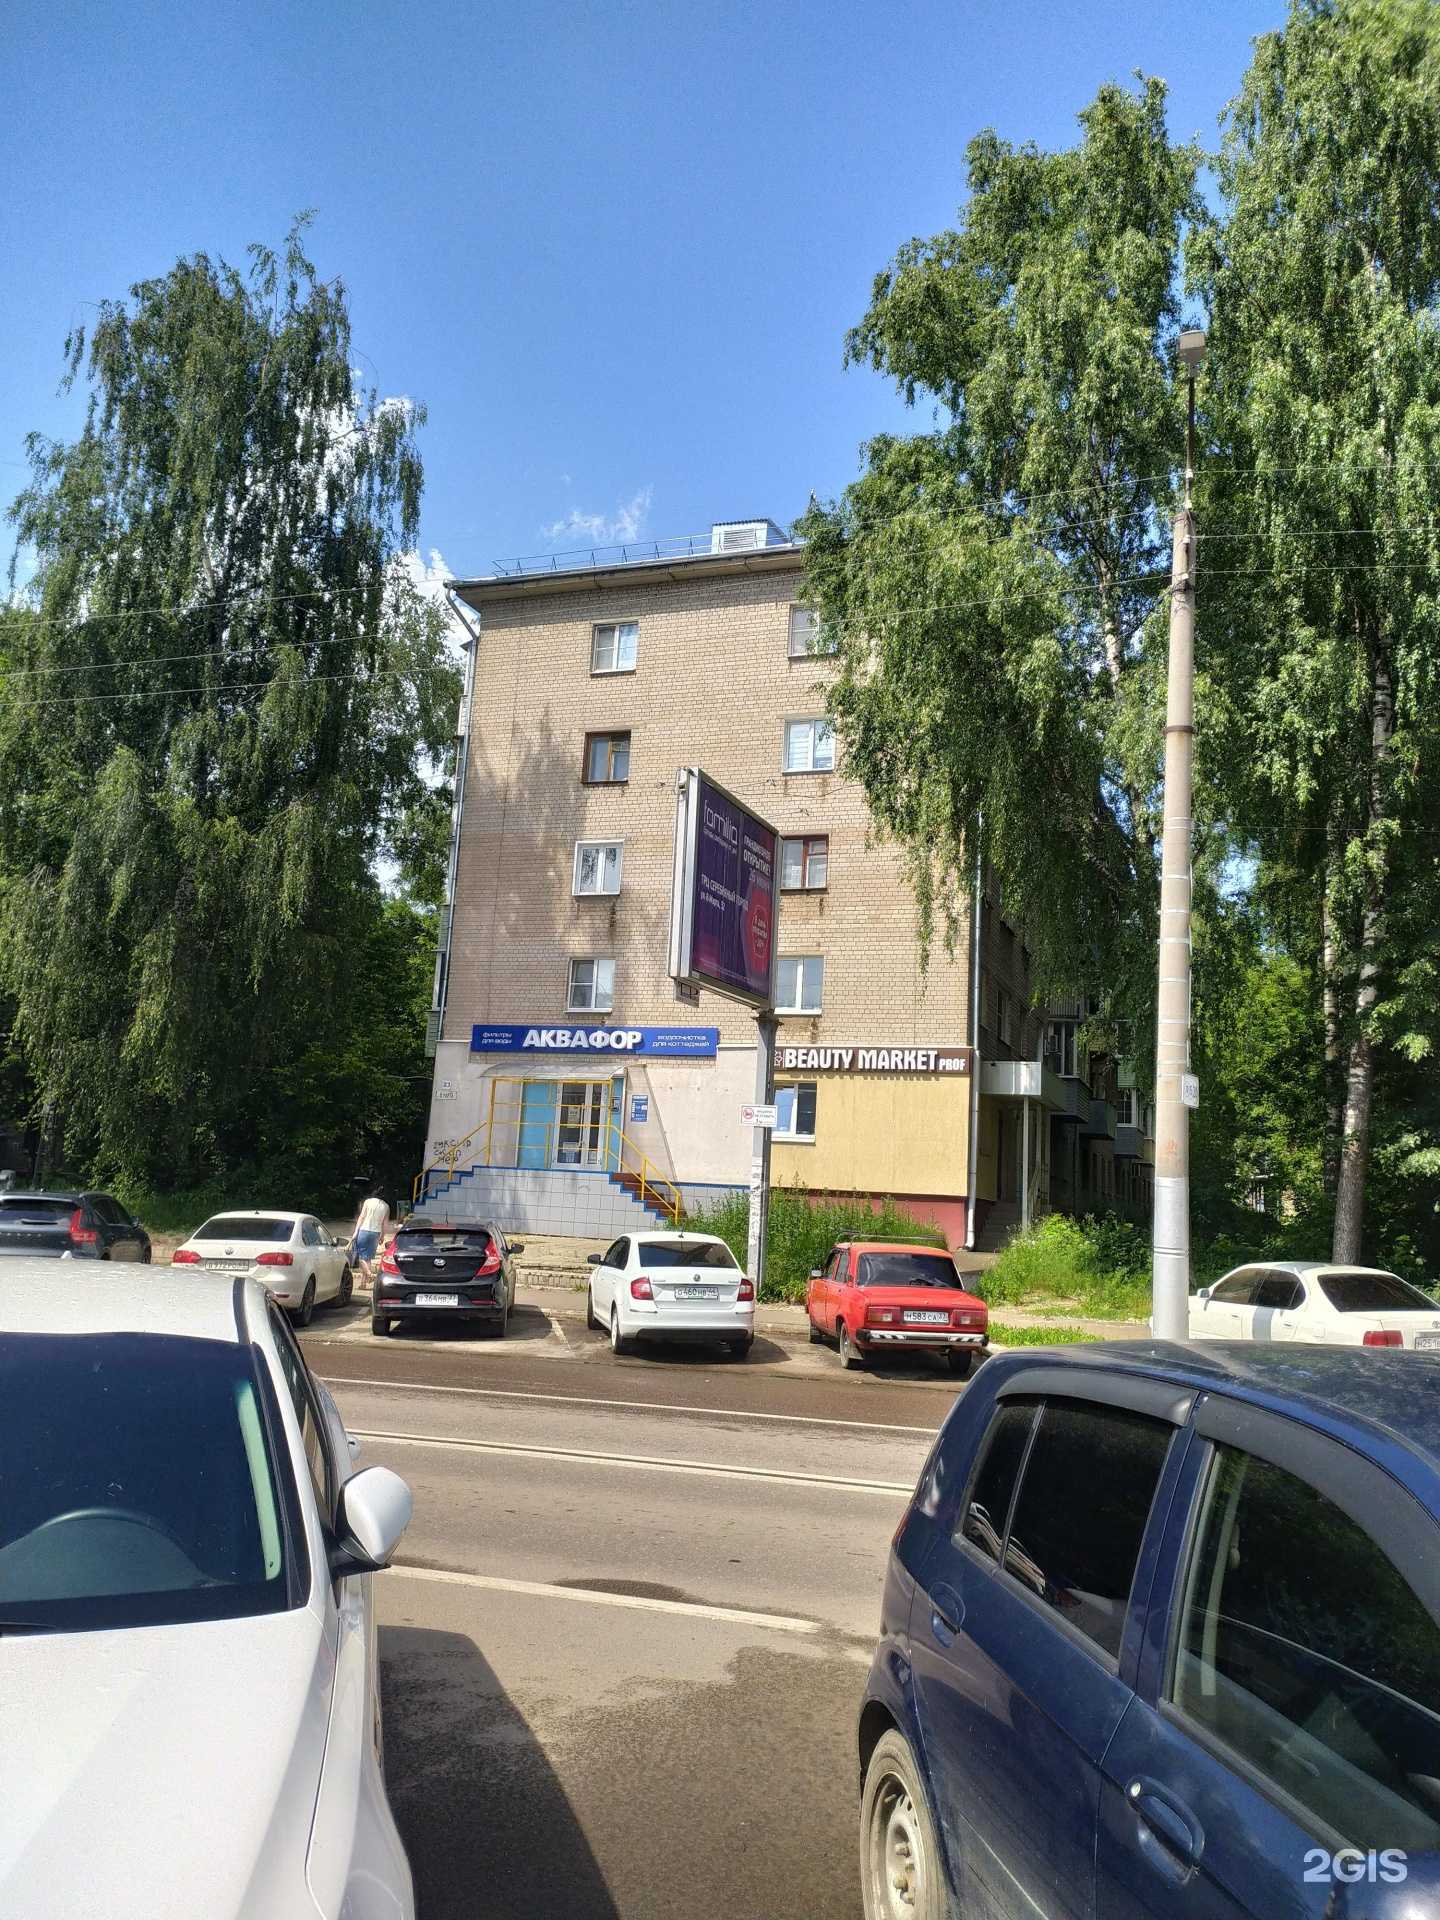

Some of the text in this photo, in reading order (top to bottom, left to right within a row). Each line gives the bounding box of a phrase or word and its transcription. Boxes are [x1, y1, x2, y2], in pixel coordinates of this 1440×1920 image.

[523, 1029, 642, 1049] АКВАФОР
[784, 1049, 966, 1071] BEAUTY MARKET PROF
